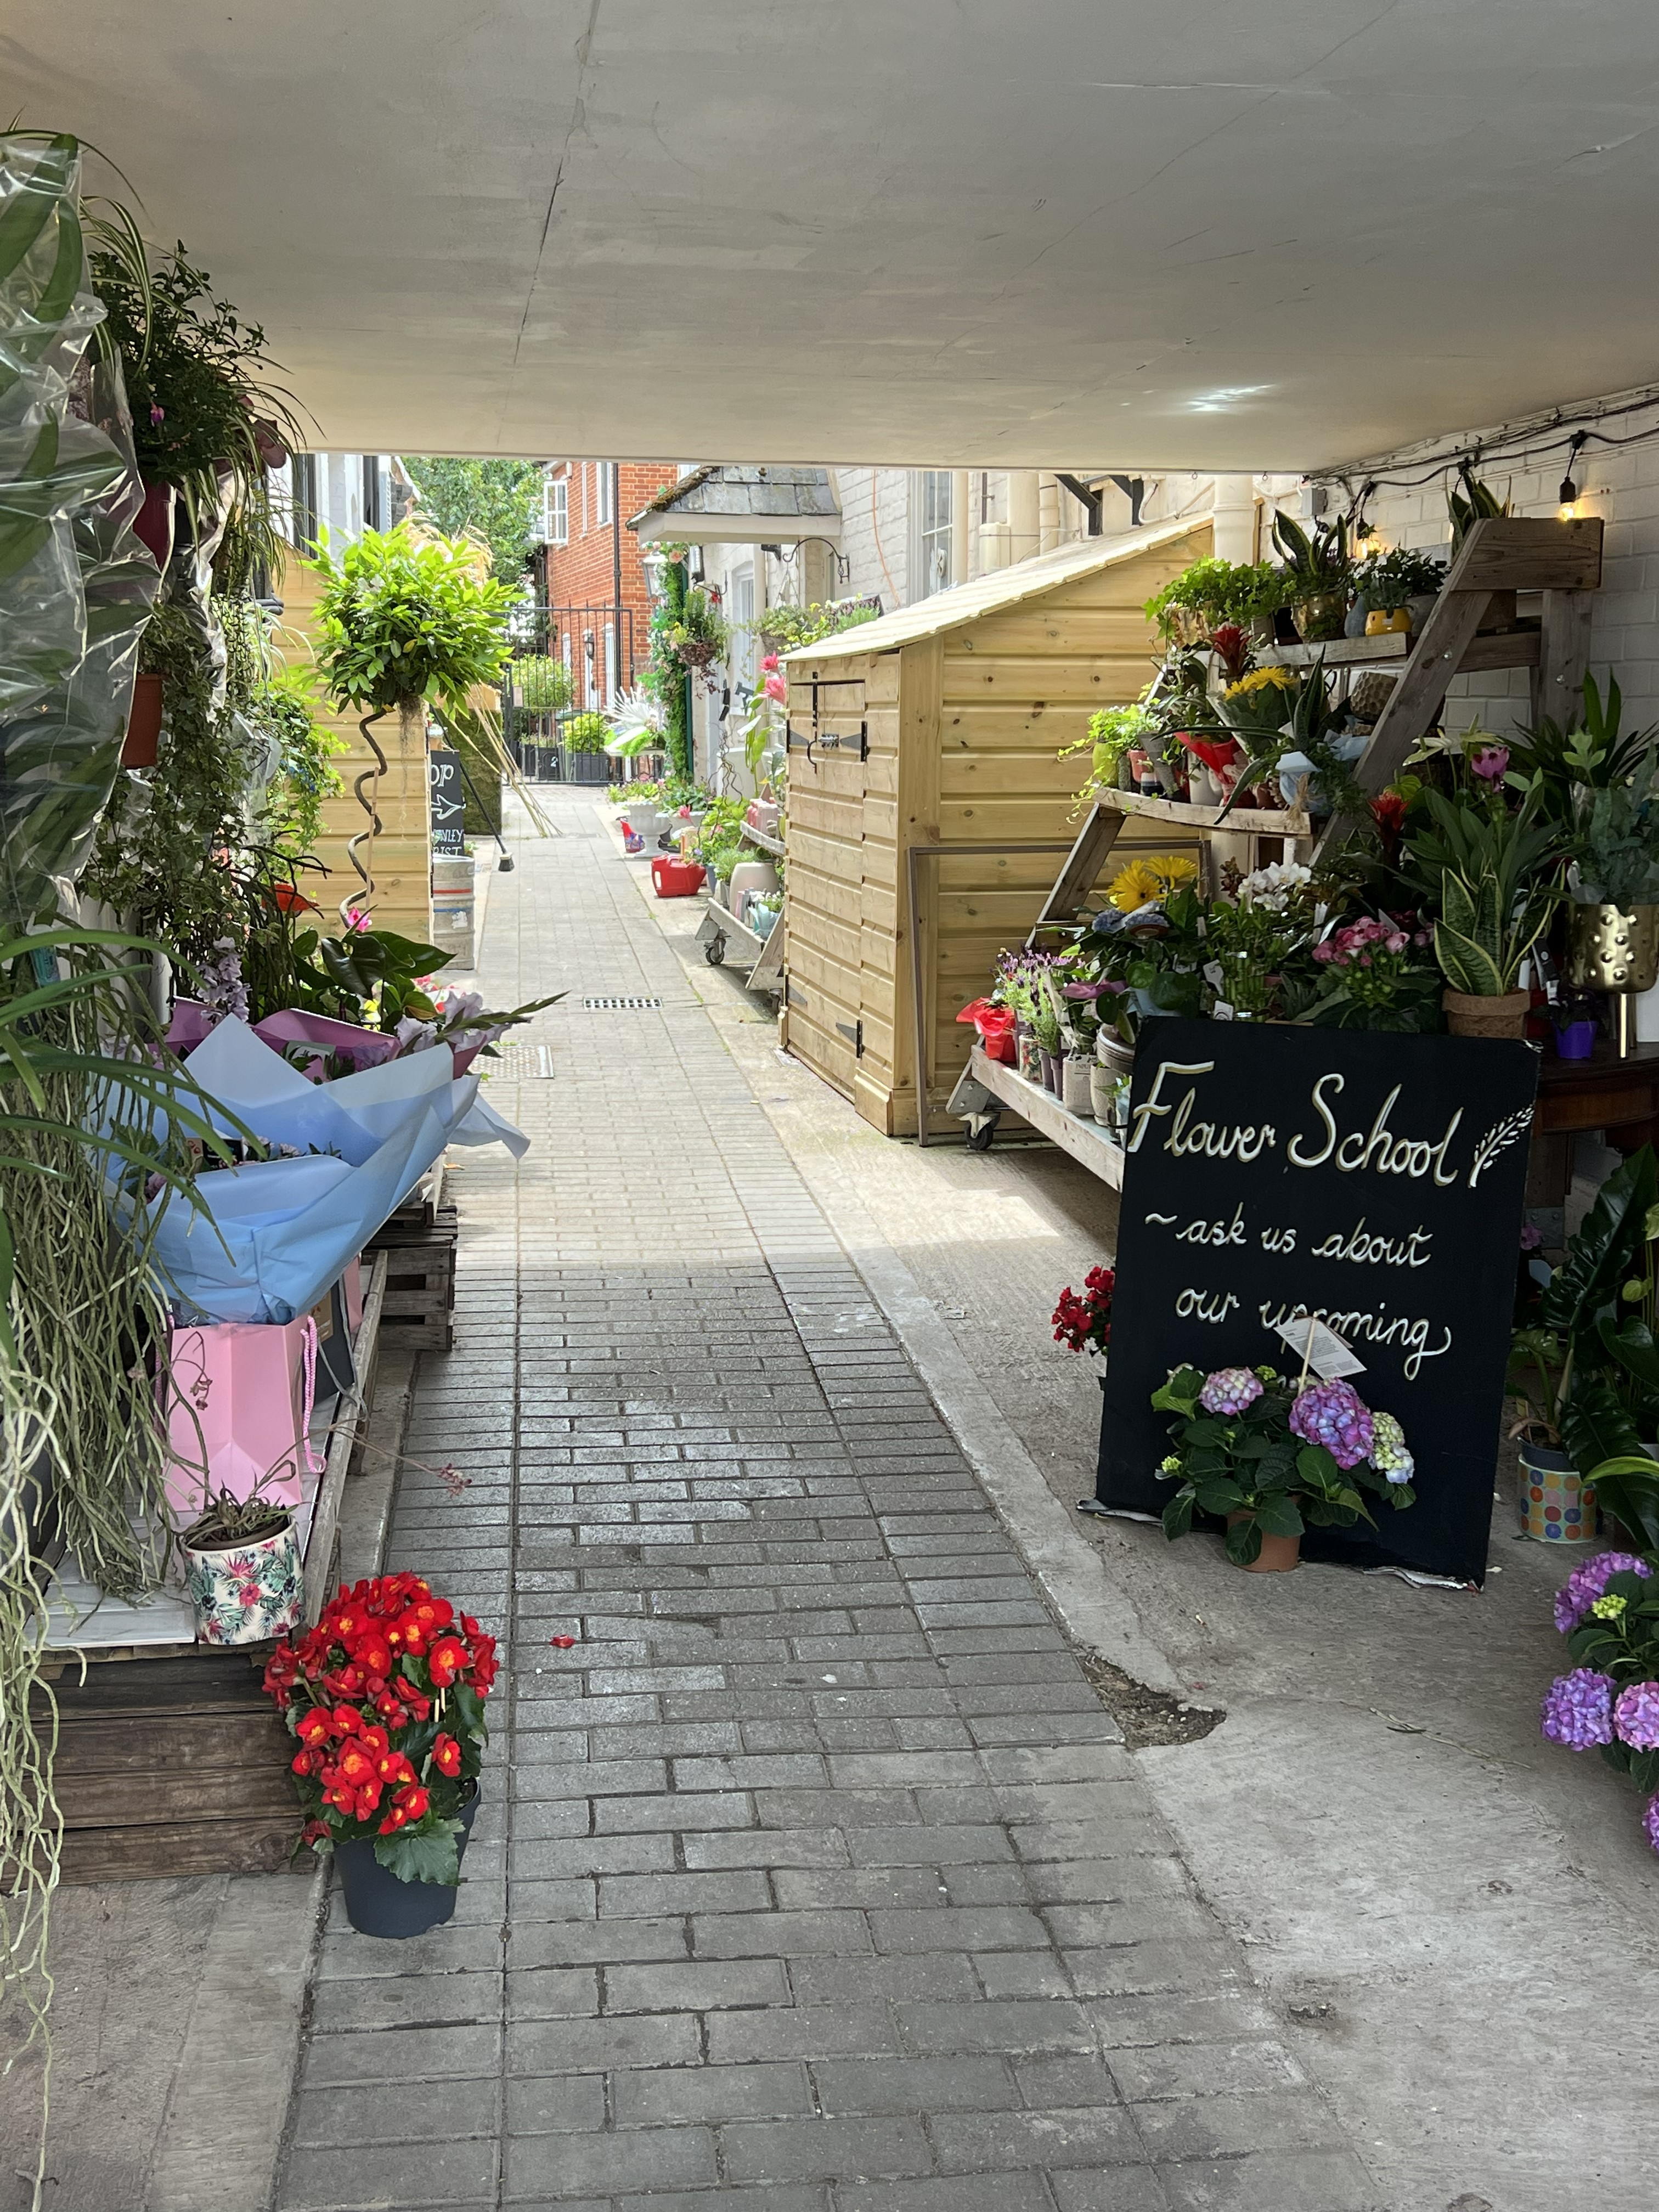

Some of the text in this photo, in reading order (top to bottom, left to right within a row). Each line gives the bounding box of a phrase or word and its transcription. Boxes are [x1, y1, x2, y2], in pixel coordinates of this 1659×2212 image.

[550, 756, 558, 767] 2
[1127, 1061, 1463, 1186] Flower School
[1261, 1228, 1296, 1253] us
[1312, 1217, 1433, 1267] about
[1176, 1289, 1240, 1323] our
